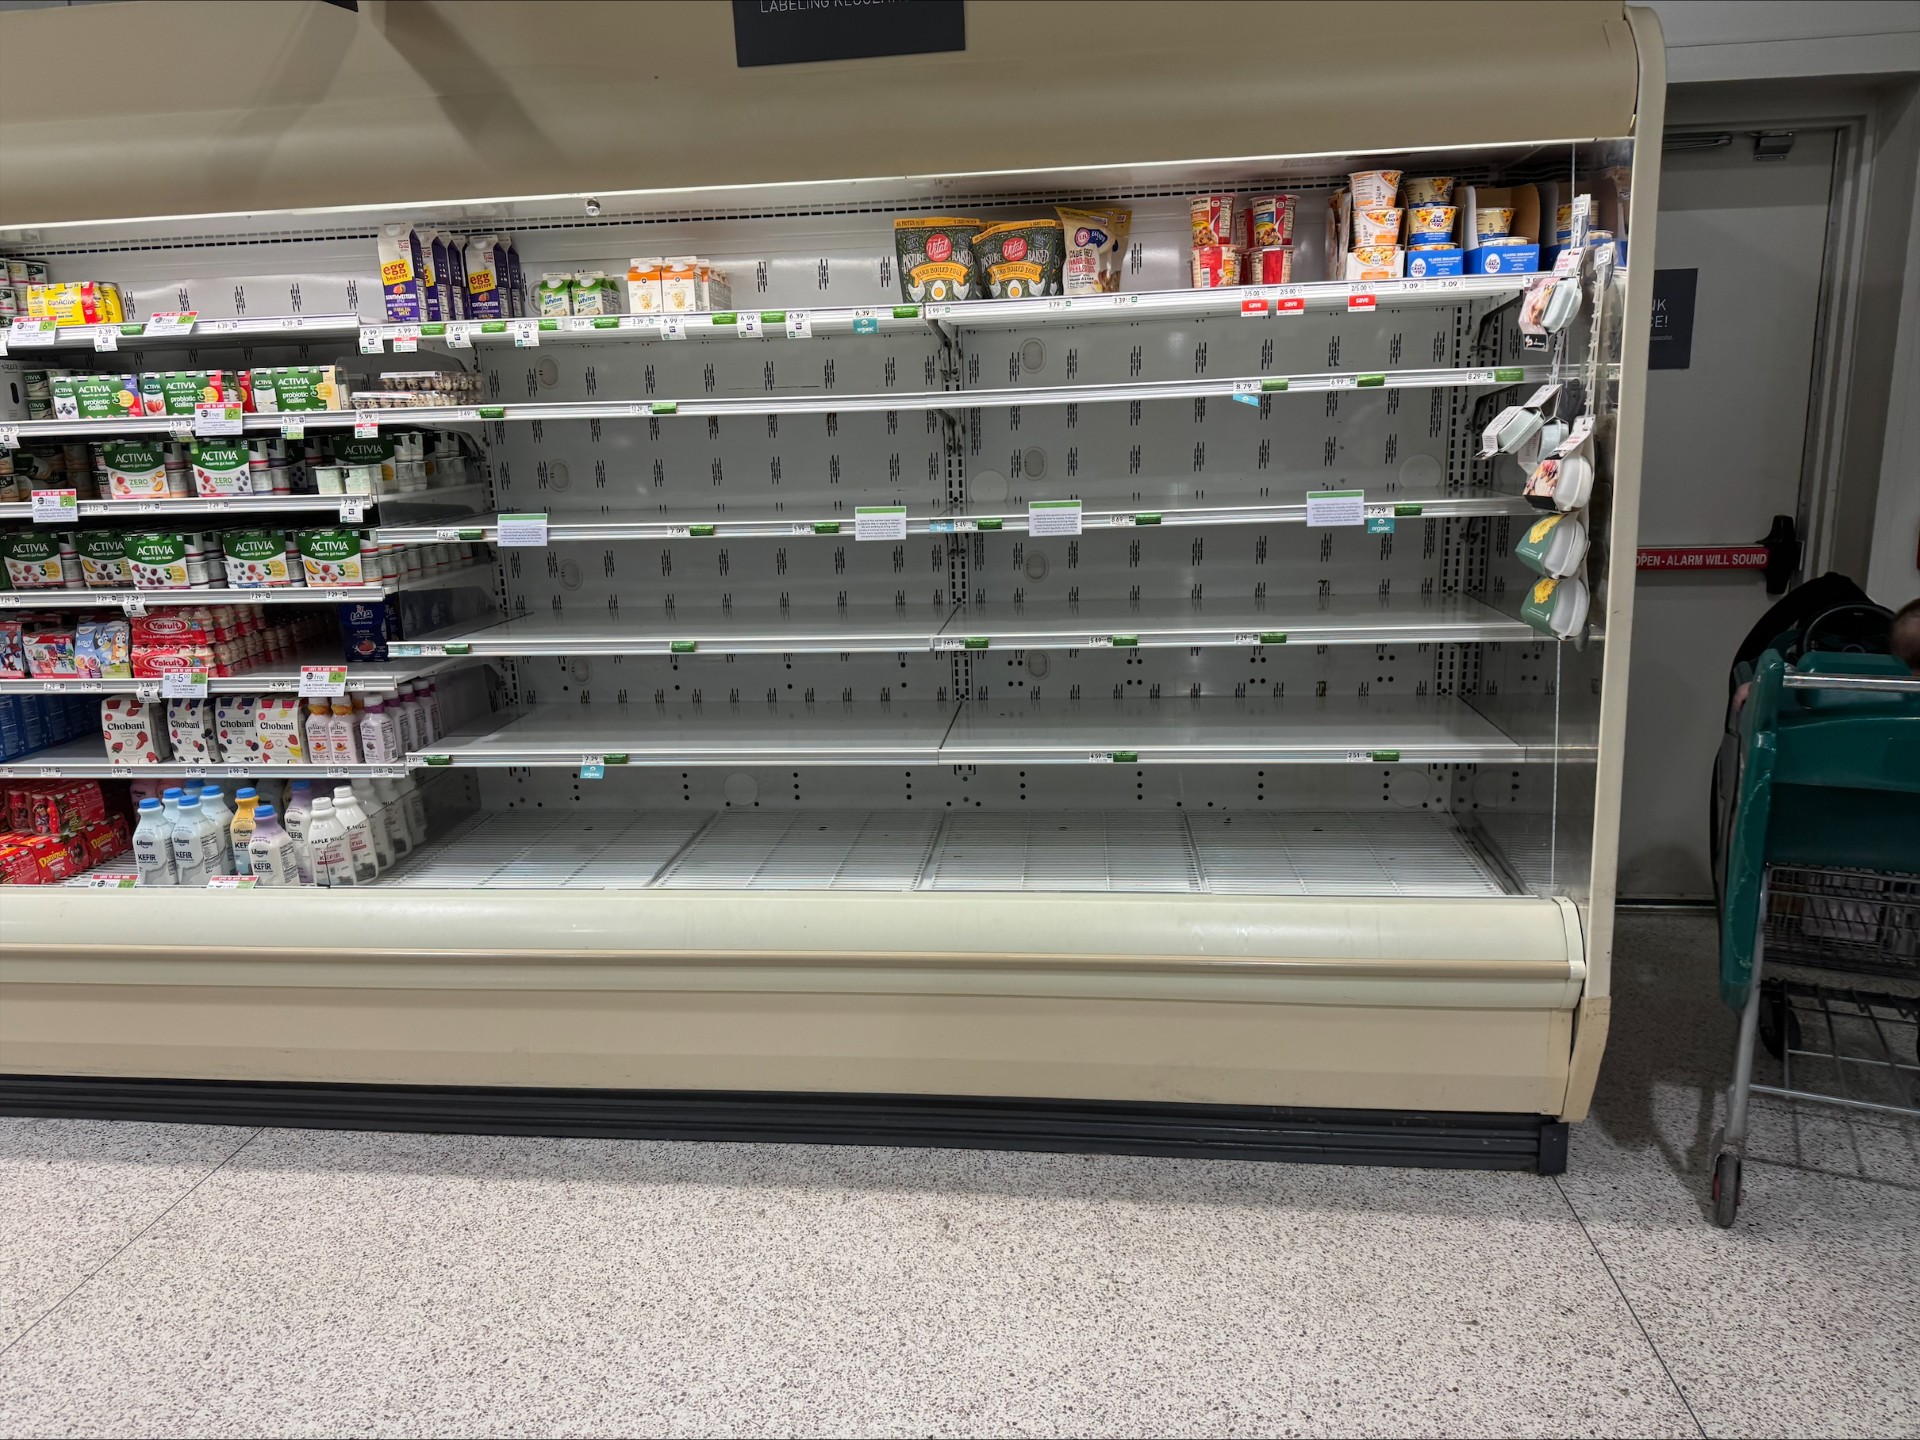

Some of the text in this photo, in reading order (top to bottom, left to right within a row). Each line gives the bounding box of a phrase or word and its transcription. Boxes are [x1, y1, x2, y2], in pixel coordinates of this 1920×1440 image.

[926, 240, 948, 255] Vital
[1002, 241, 1023, 256] Vital
[902, 250, 974, 274] PASTURE RAISED
[1028, 250, 1050, 265] RAISED
[383, 262, 406, 276] egg
[916, 266, 962, 278] HARD BOILED EGGS
[1025, 266, 1038, 276] EGGS
[386, 273, 408, 282] beaters
[470, 272, 490, 284] egg
[1402, 282, 1418, 290] 3.09
[857, 326, 874, 334] organic
[166, 382, 196, 390] ACTIVIA
[278, 377, 310, 386] ACTIVIA
[78, 386, 111, 394] ACTIVIA
[170, 395, 196, 404] probiotic
[282, 391, 309, 400] probiotic
[286, 396, 306, 404] dailies
[83, 398, 110, 406] probiotic
[174, 400, 194, 408] dailies
[344, 444, 384, 454] ACTIVIA
[115, 452, 154, 464] ACTIVIA
[201, 450, 238, 461] ACTIVIA
[130, 478, 148, 486] ZERO
[12, 542, 50, 554] ACTIVIA
[88, 541, 125, 552] ACTIVIA
[137, 545, 174, 556] ACTIVIA
[236, 541, 274, 552] ACTIVIA
[310, 541, 349, 552] ACTIVIA
[1666, 554, 1703, 566] ALARM
[1706, 554, 1730, 566] WILL
[1732, 554, 1768, 565] SOUND
[39, 564, 47, 576] 3
[114, 562, 122, 575] 3
[264, 564, 272, 576] 3
[338, 564, 346, 576] 3
[165, 568, 172, 580] 3
[351, 610, 373, 620] LALA
[152, 620, 182, 630] Yakult
[152, 657, 183, 667] Yakult
[108, 722, 146, 731] Chobani
[170, 720, 200, 729] Chobani
[220, 720, 254, 728] Chobani
[260, 722, 294, 730] Chobani
[308, 723, 326, 733] pillars
[330, 723, 346, 733] pillars
[138, 854, 156, 862] KEFIR
[320, 852, 340, 860] KEFIR
